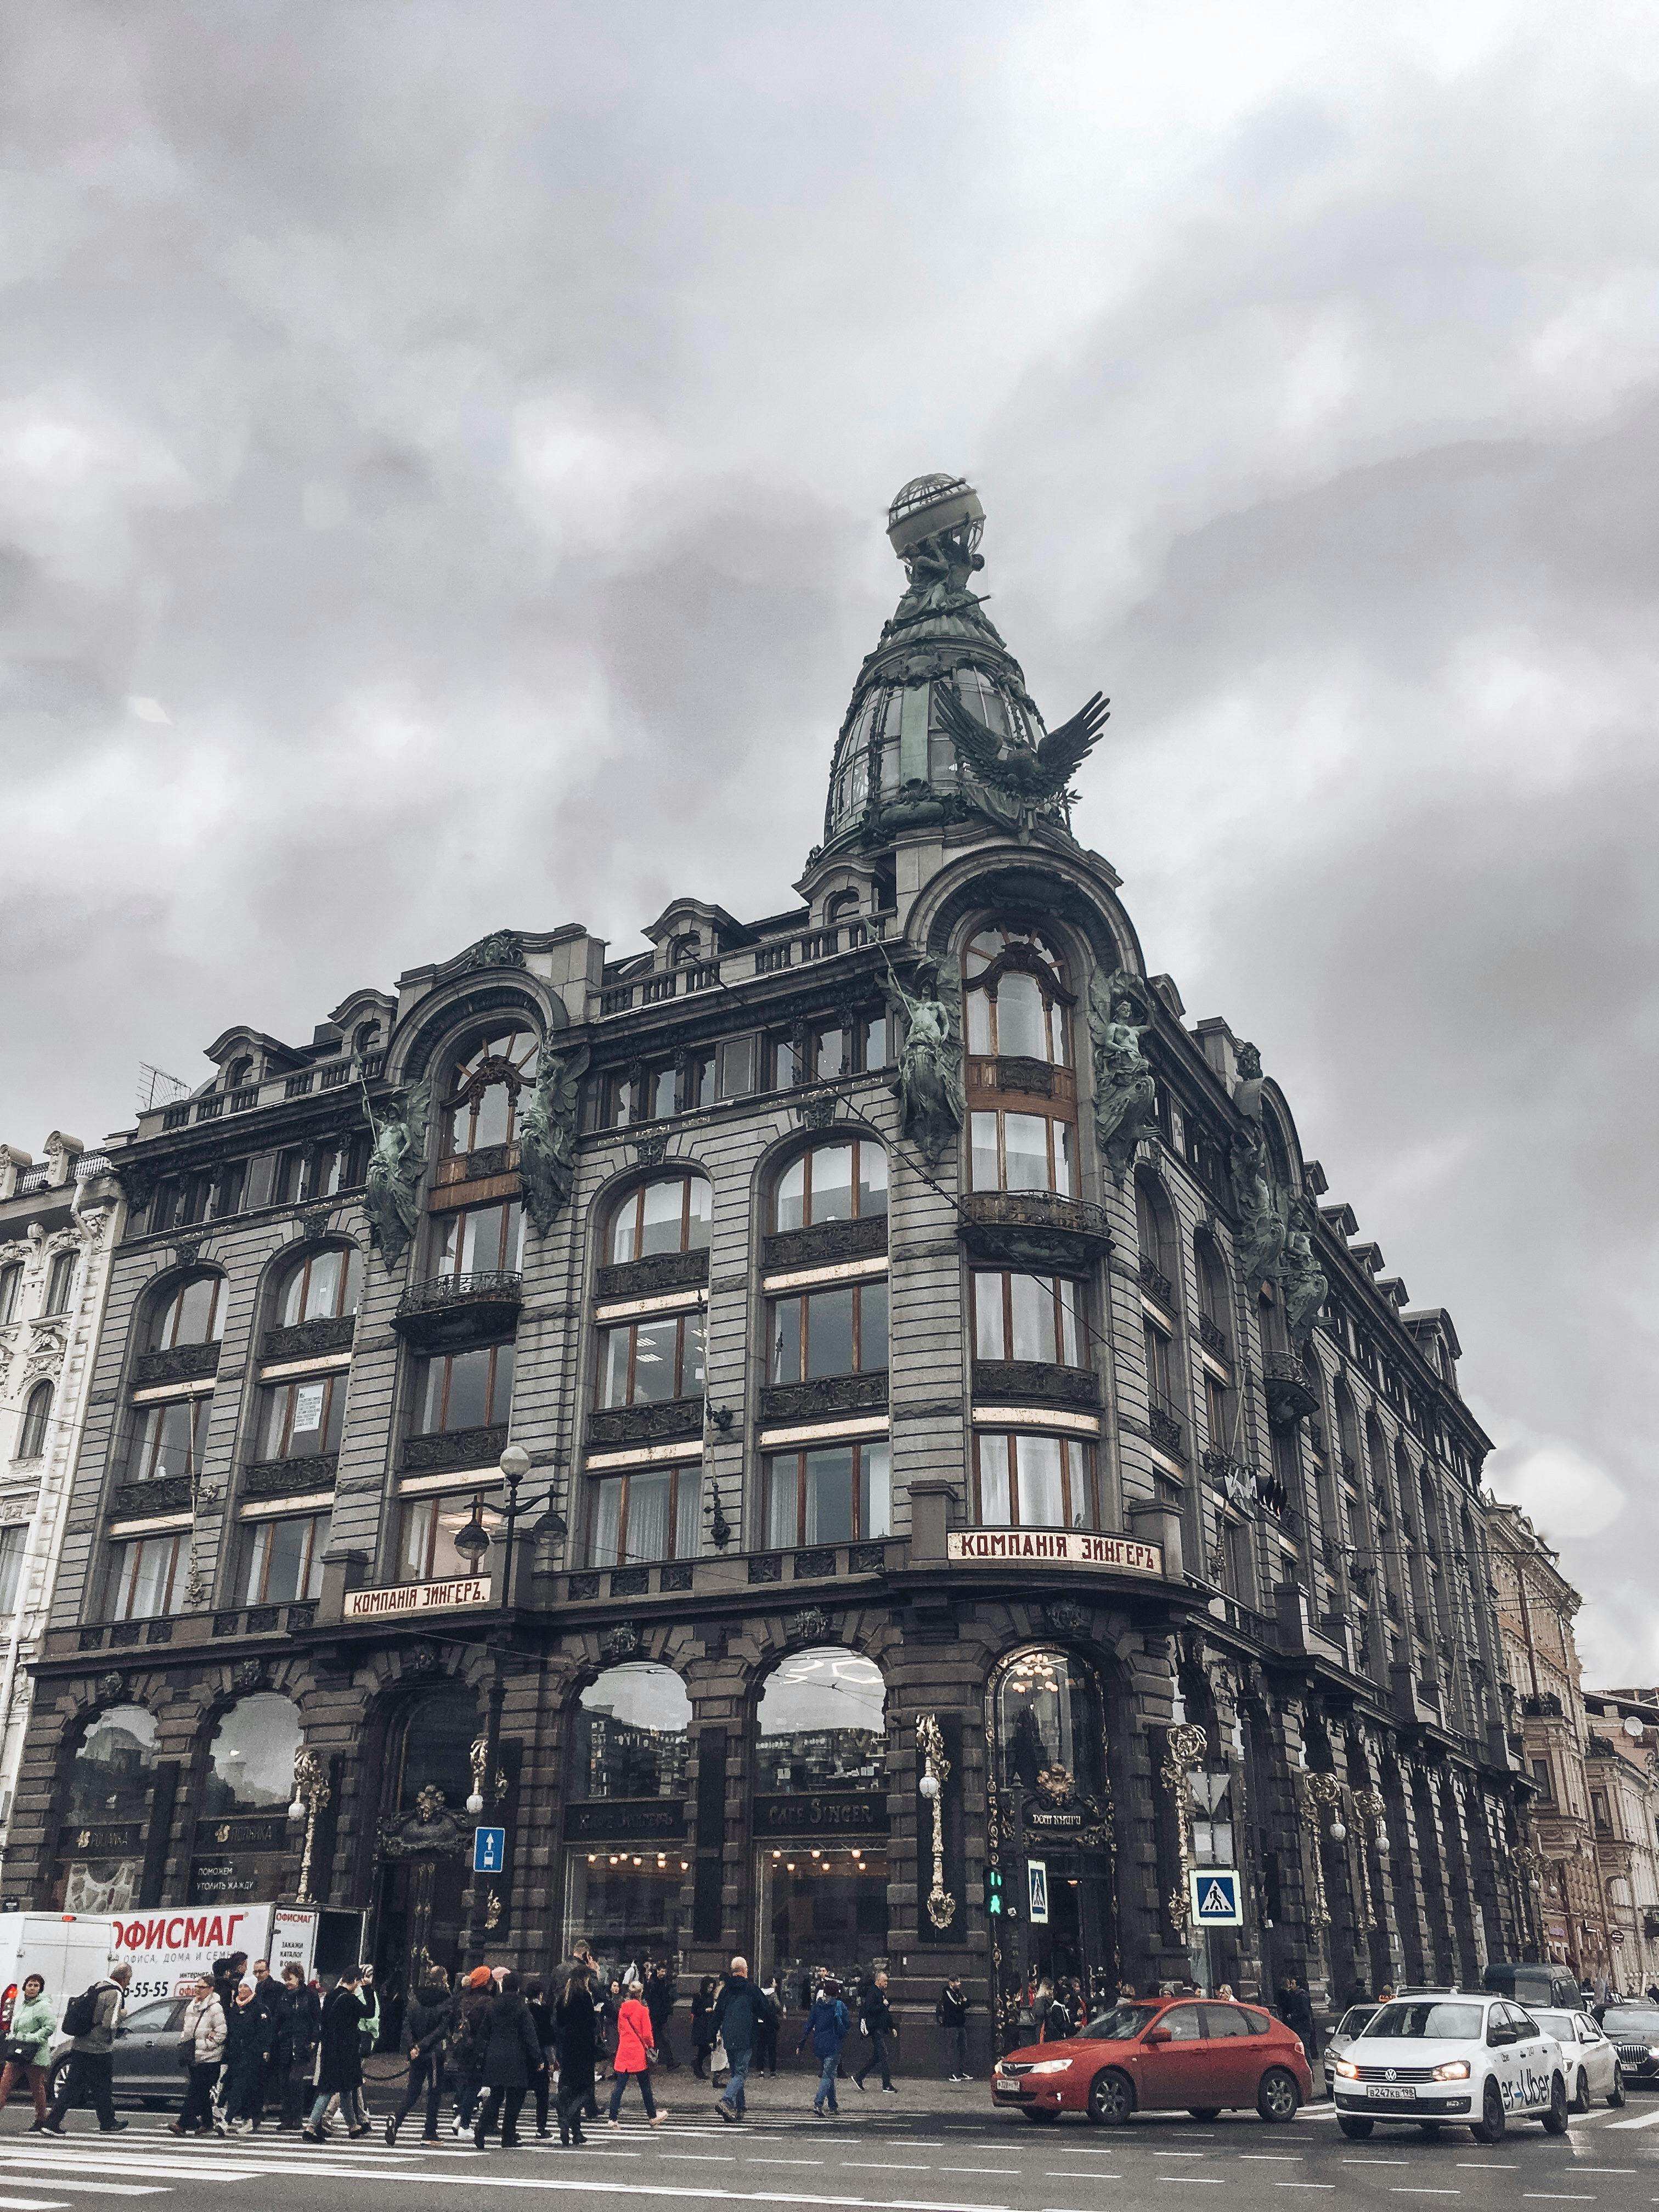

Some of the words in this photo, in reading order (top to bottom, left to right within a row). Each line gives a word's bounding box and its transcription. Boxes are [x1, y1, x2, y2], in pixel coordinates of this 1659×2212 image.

[1081, 1538, 1154, 1570] ЗИНГЕРЪ
[196, 1882, 226, 1891] УТОЛИТЬ
[227, 1881, 254, 1890] ЖАЖДУ
[275, 1912, 313, 1923] ОФИСМАГ
[163, 1952, 190, 1963] ДОМА
[196, 1952, 202, 1961] И
[1520, 2068, 1550, 2106] Uber
